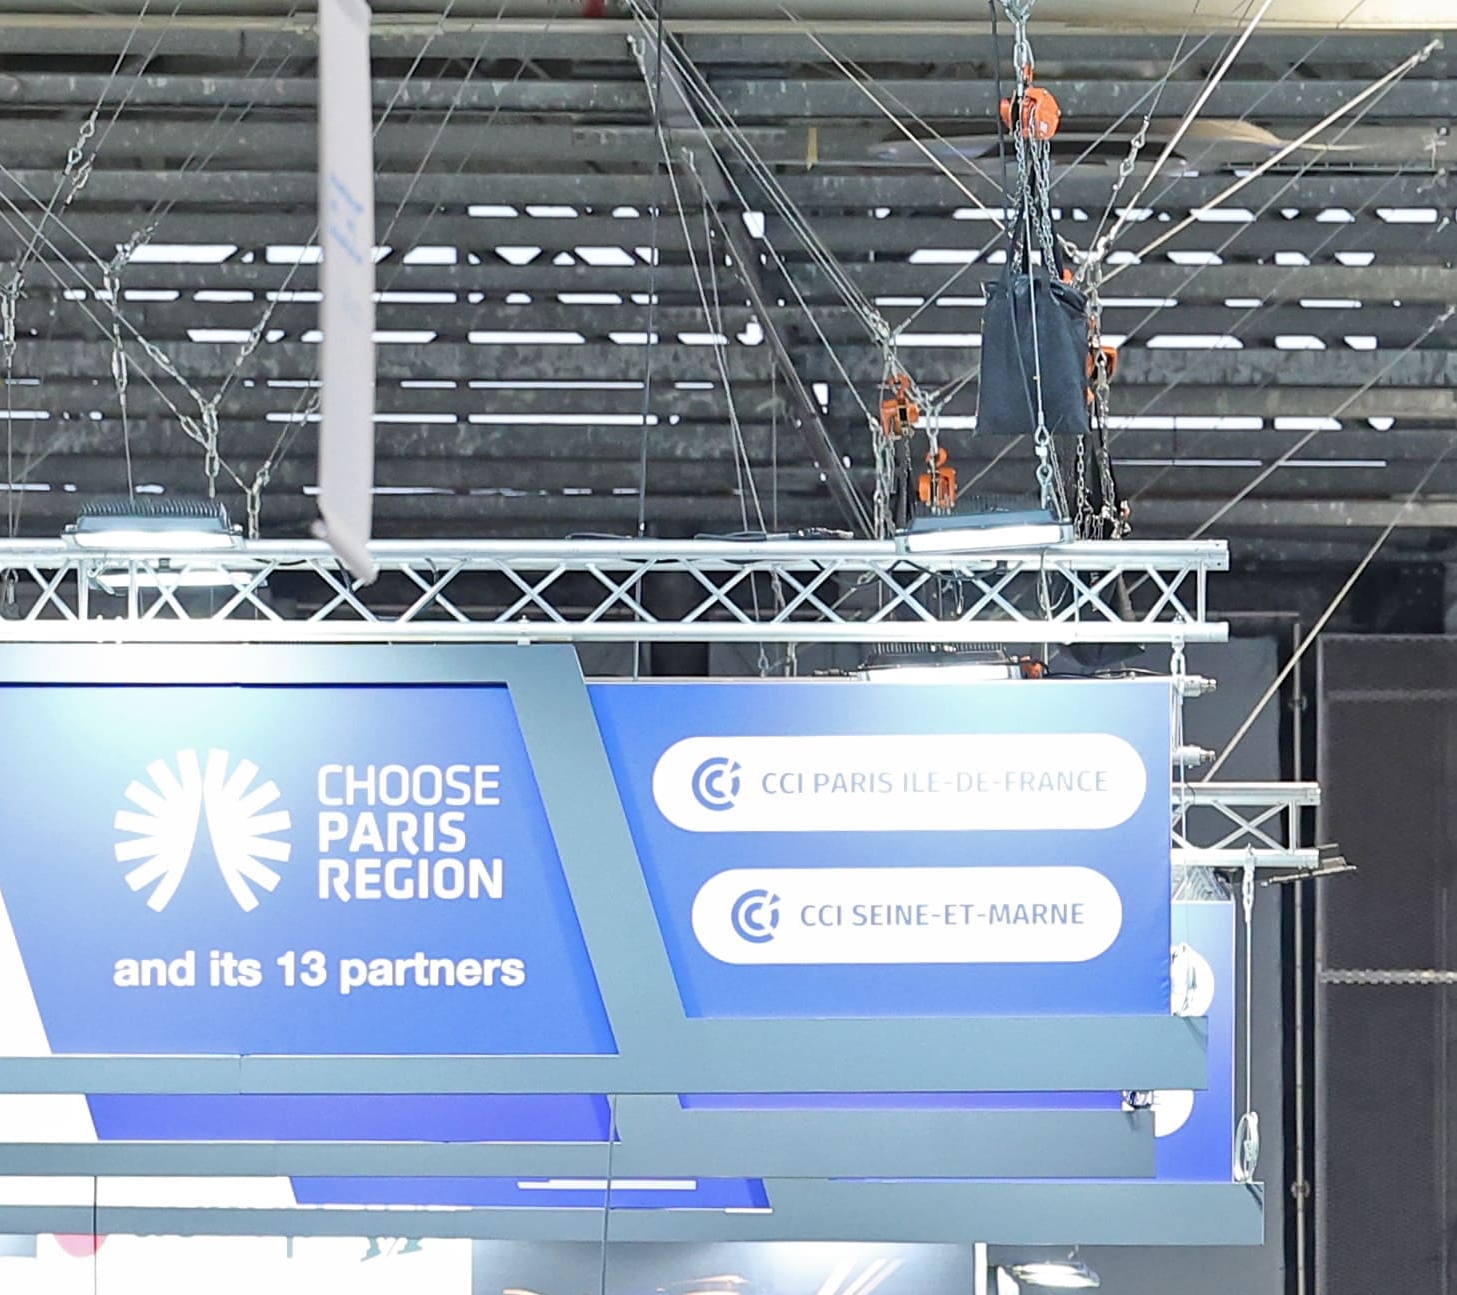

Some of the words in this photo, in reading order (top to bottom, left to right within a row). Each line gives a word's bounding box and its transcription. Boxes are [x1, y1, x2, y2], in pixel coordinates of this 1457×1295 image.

[318, 764, 499, 806] CHOOSE
[761, 772, 804, 796] CCI
[813, 771, 893, 794] PARIS
[901, 770, 1109, 793] ILE-DE-FRANCE
[318, 811, 466, 855] PARIS
[318, 858, 503, 903] REGION
[800, 903, 844, 928] CCI
[851, 902, 1085, 926] SEINE-ET-MARNE
[113, 951, 195, 988] and
[210, 951, 263, 988] its
[276, 952, 327, 987] 13
[340, 953, 526, 994] partners
